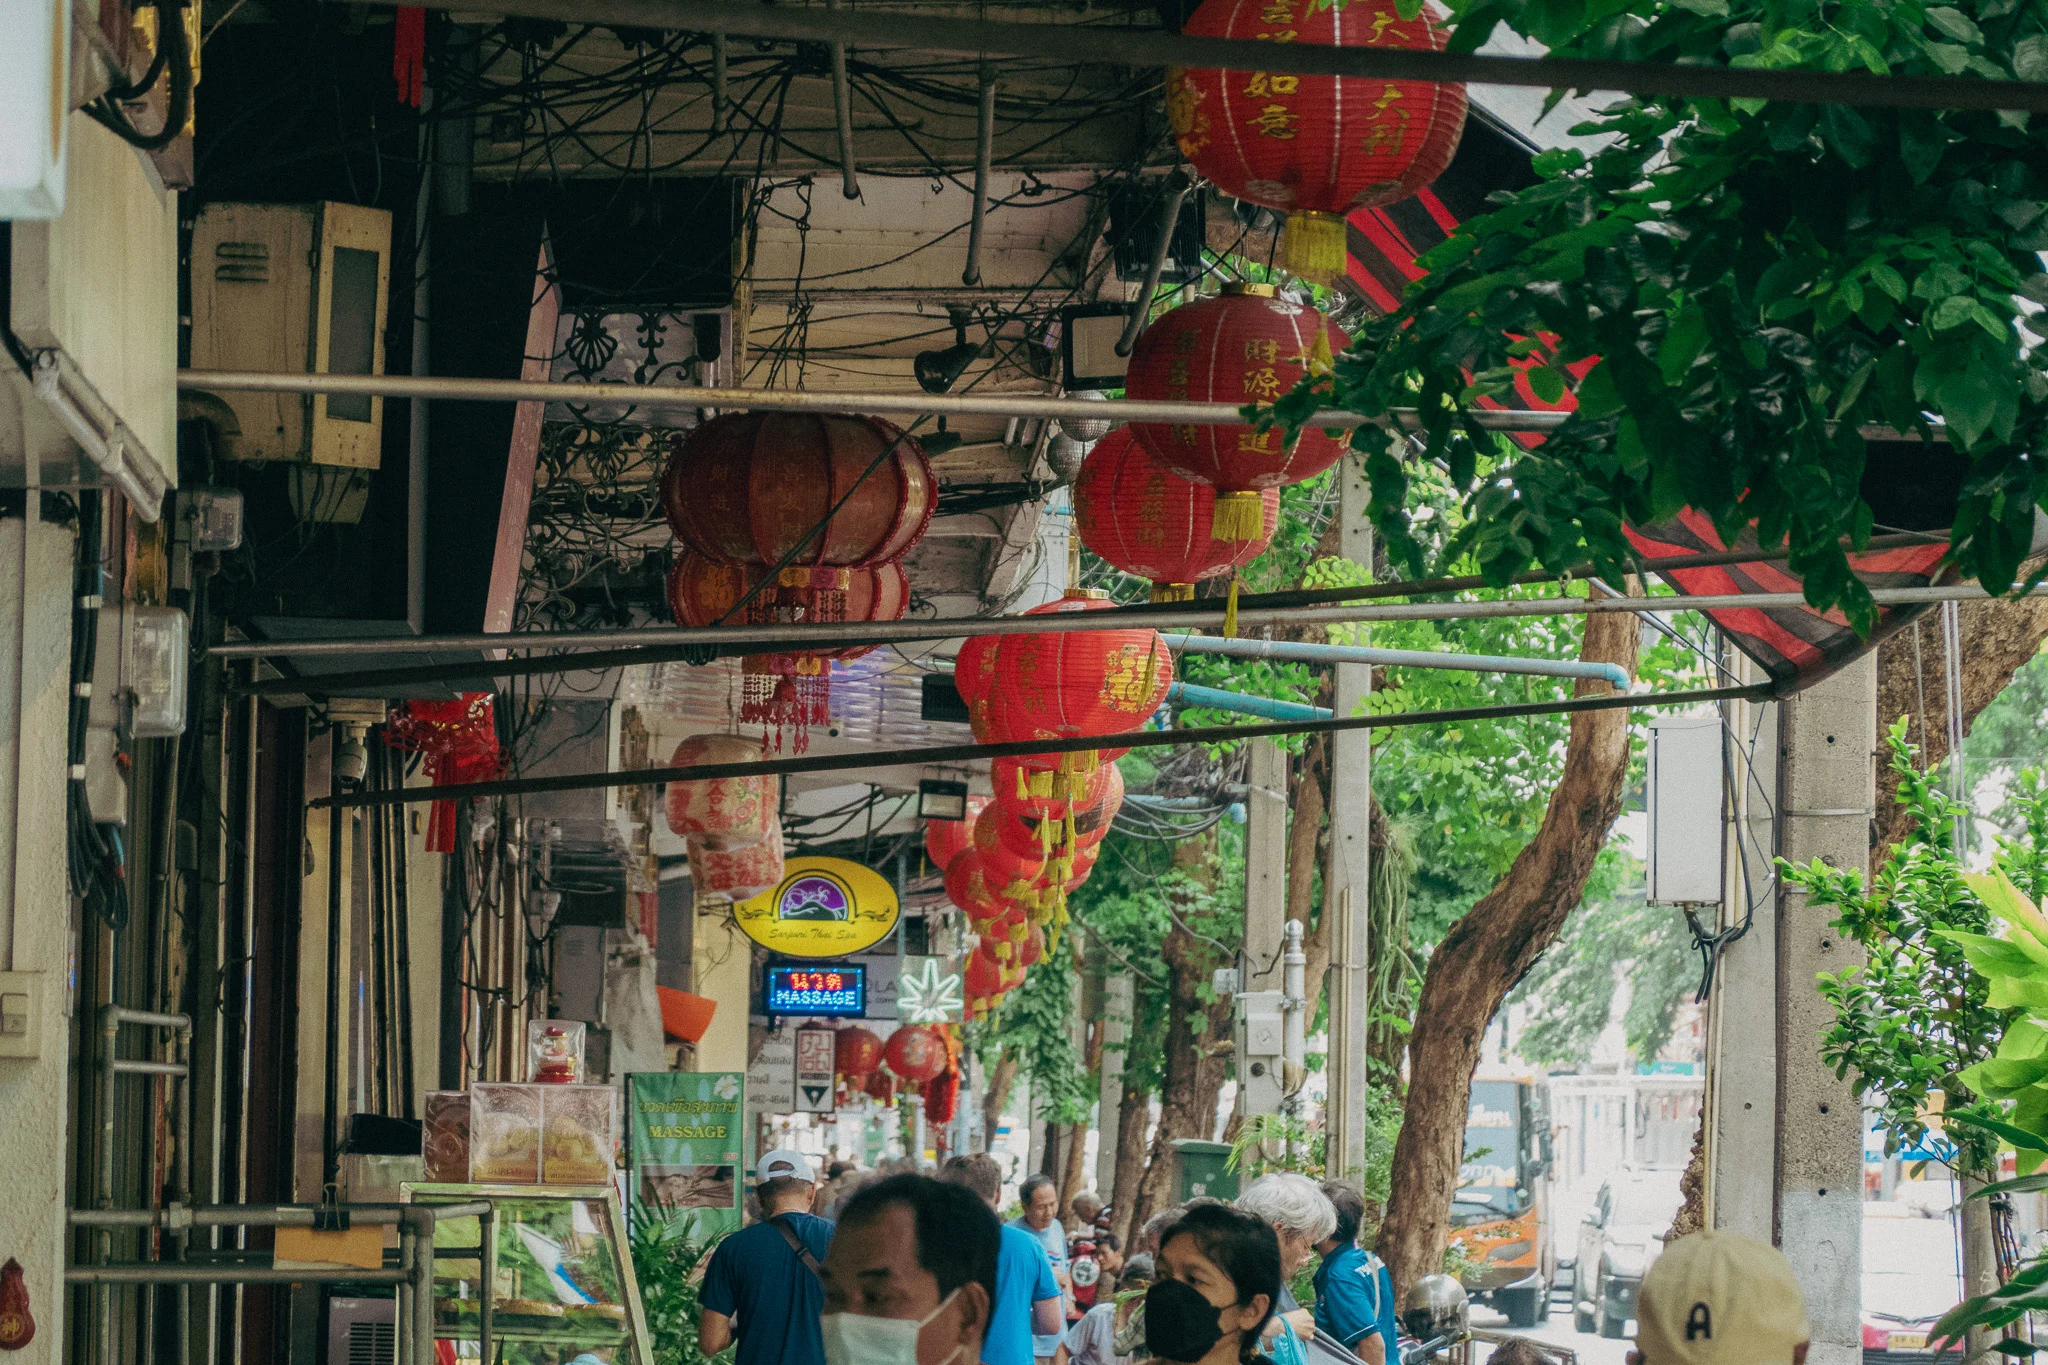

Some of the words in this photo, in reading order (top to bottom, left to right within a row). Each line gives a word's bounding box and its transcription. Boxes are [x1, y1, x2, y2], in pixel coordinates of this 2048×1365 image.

[776, 990, 856, 1006] MASSAGE
[649, 1125, 727, 1138] MASSAGE
[1685, 1301, 1712, 1341] A
